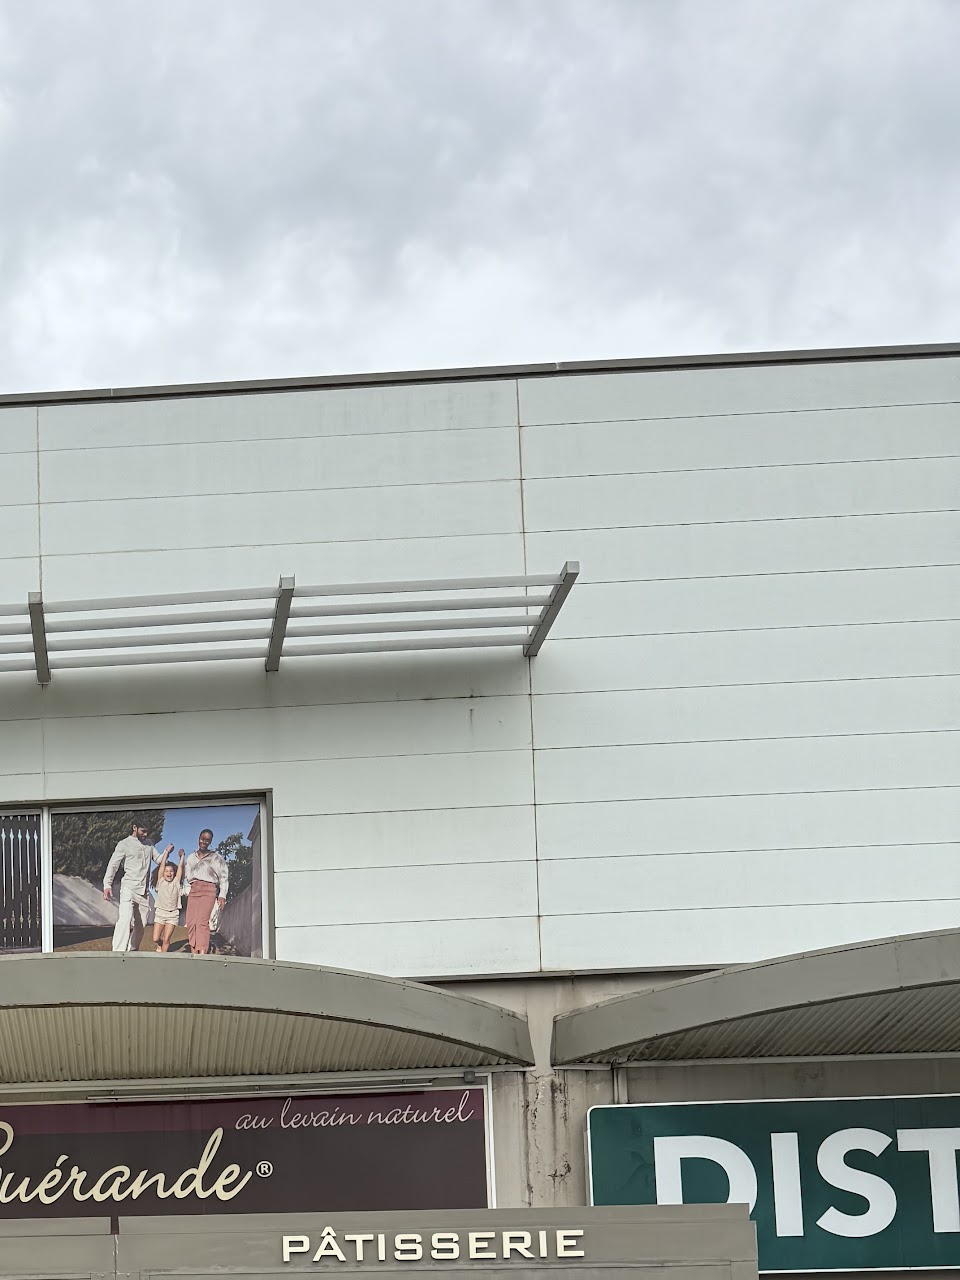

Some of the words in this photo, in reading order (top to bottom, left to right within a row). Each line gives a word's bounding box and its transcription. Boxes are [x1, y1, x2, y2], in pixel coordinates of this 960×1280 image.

[235, 1113, 274, 1130] au
[280, 1097, 363, 1129] levain
[367, 1090, 474, 1123] naturel
[282, 1226, 586, 1262] PÂTISSERIE
